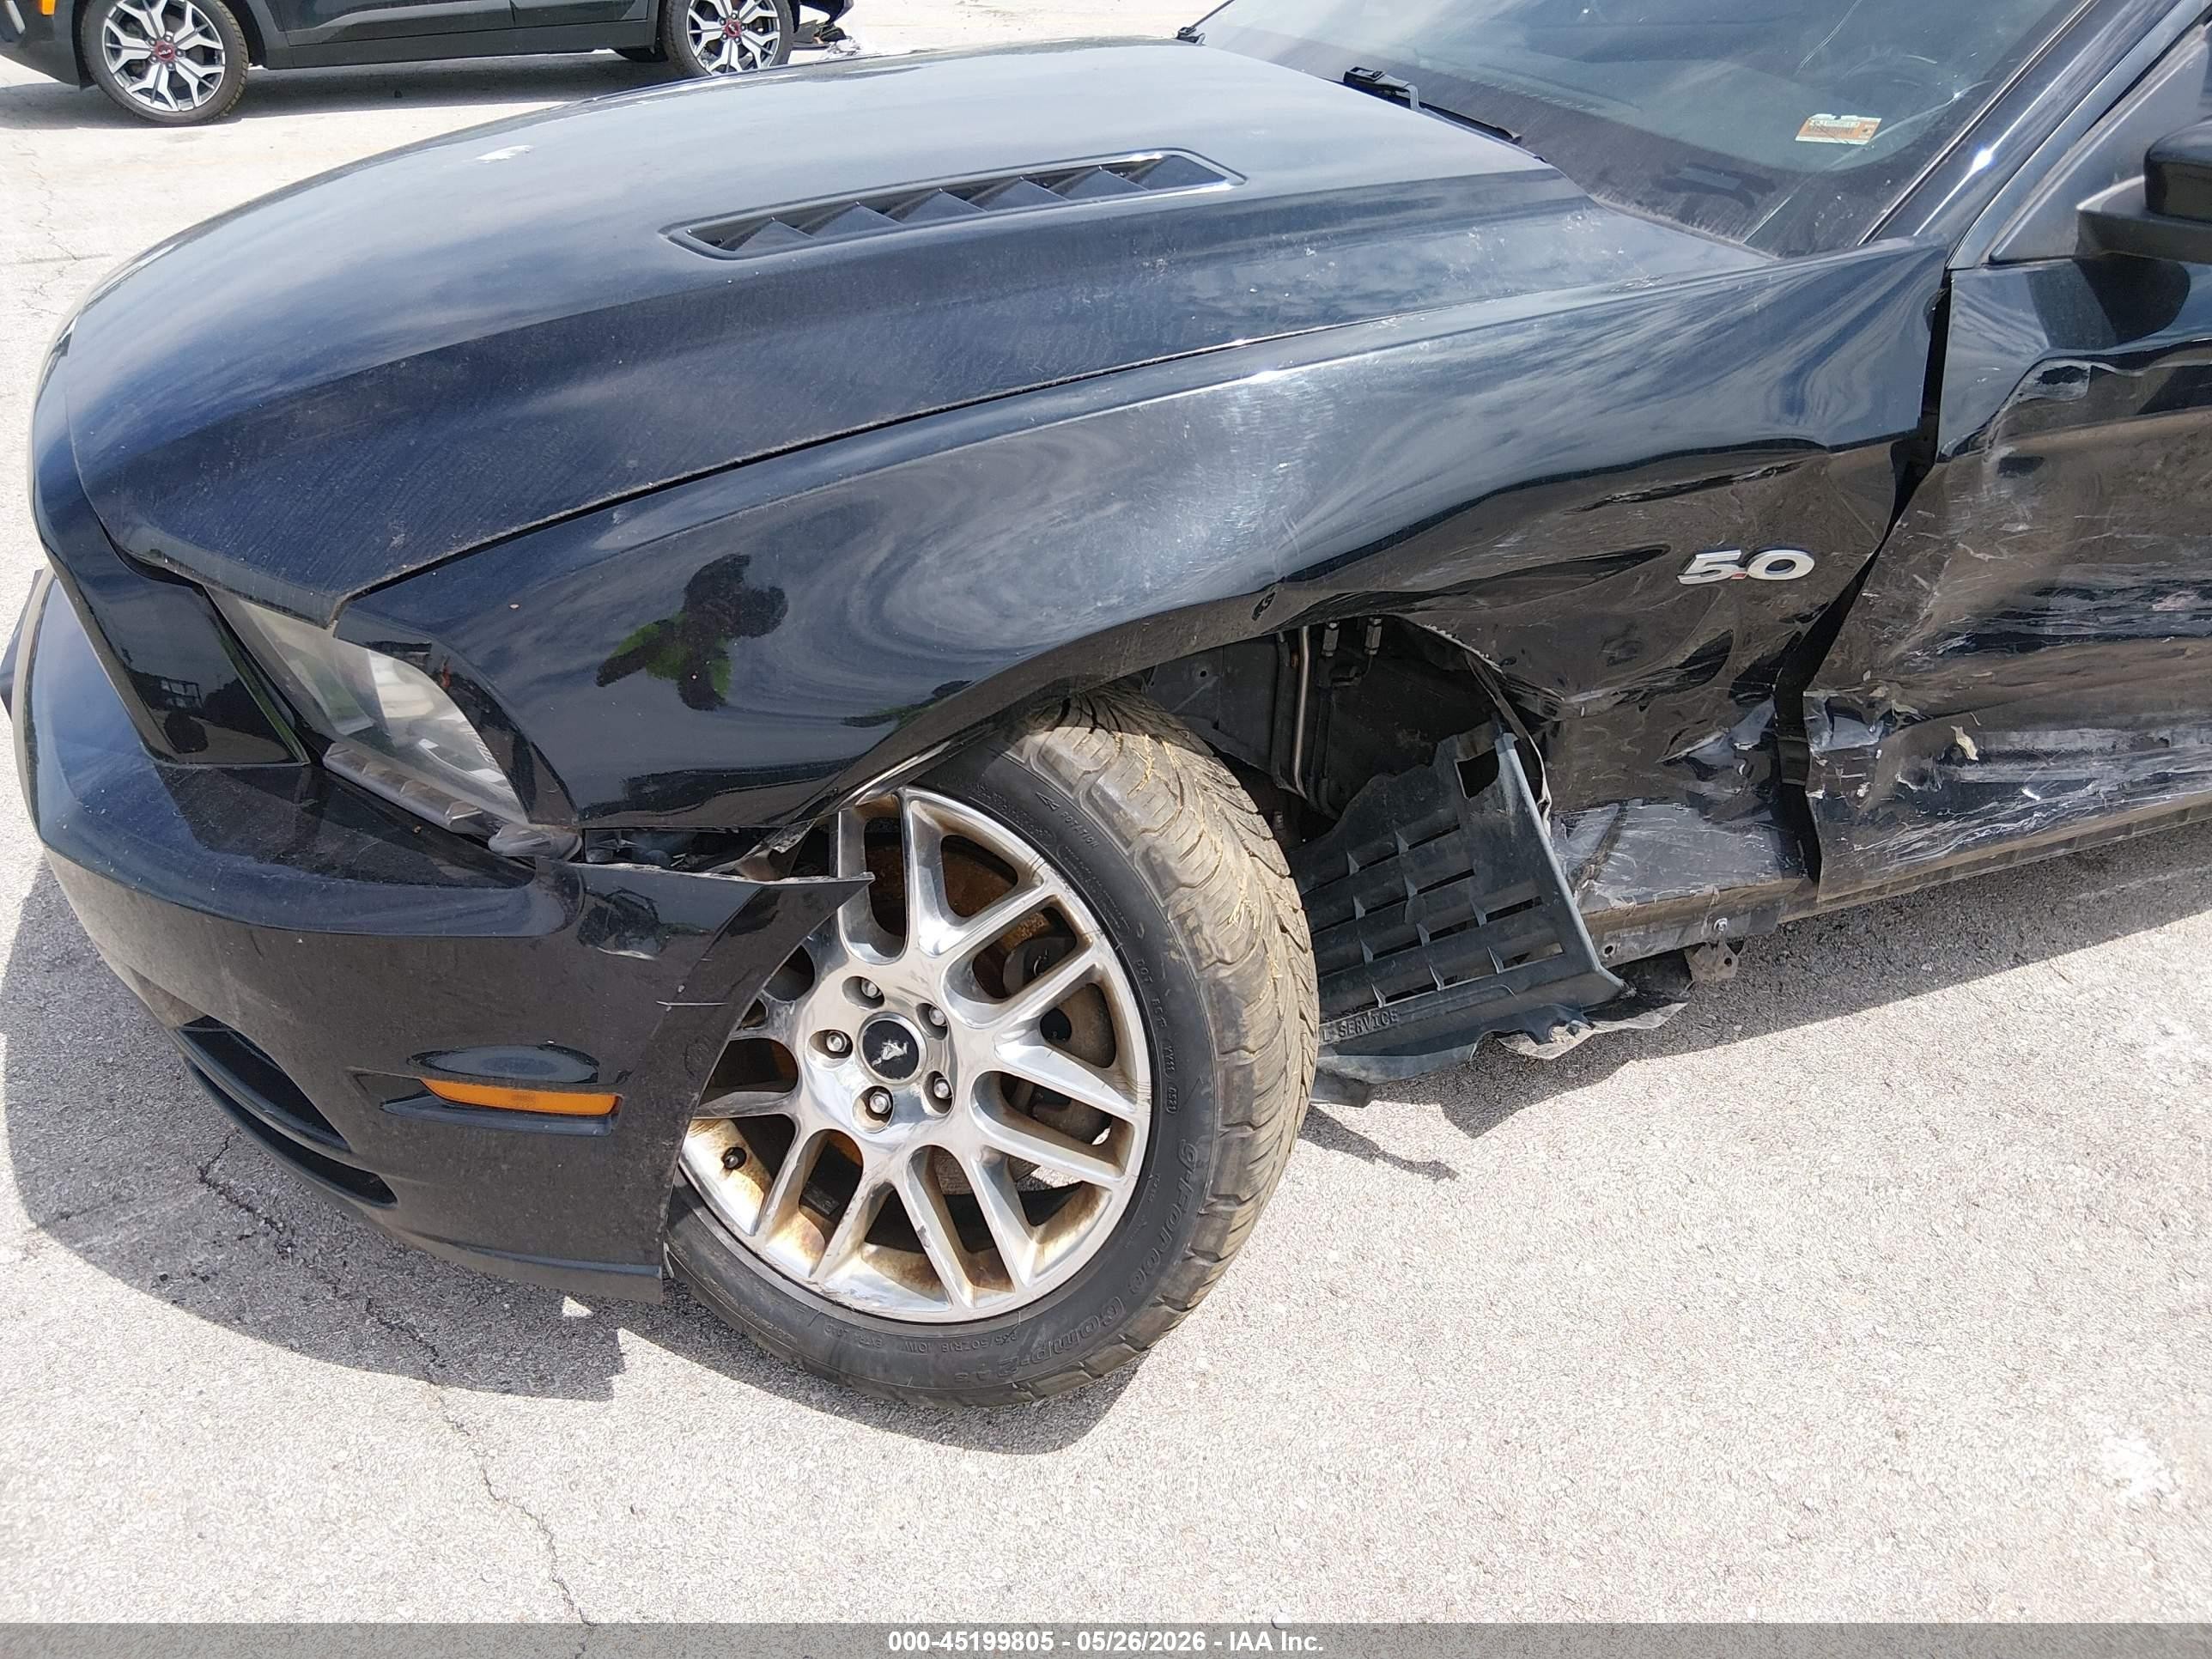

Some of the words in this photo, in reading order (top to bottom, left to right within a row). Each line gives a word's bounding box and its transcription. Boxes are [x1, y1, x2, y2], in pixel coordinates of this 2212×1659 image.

[1676, 549, 1815, 586] 5.0
[1060, 811, 1100, 849] ROTATION
[1339, 1008, 1400, 1038] SERVICE
